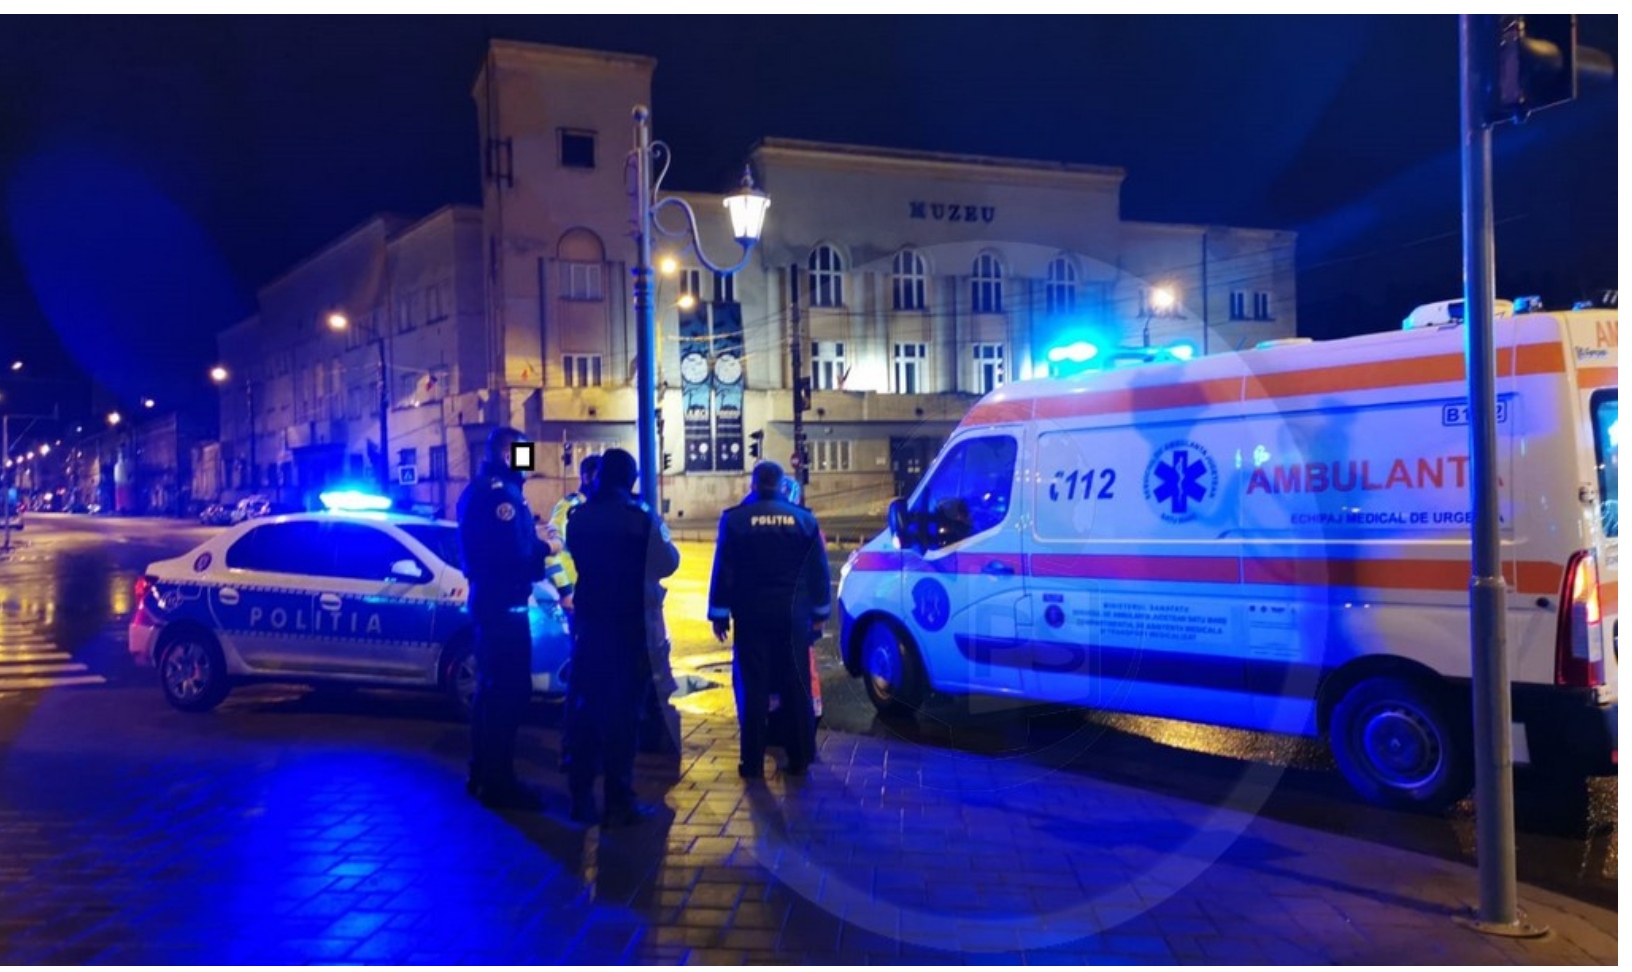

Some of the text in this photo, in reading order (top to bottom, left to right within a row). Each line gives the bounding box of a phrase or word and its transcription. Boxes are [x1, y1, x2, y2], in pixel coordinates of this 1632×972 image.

[909, 200, 997, 223] MUZEU
[1066, 468, 1116, 500] 112
[1346, 512, 1404, 525] MEDICAL
[1409, 512, 1429, 525] DE
[250, 606, 382, 633] POLITIA
